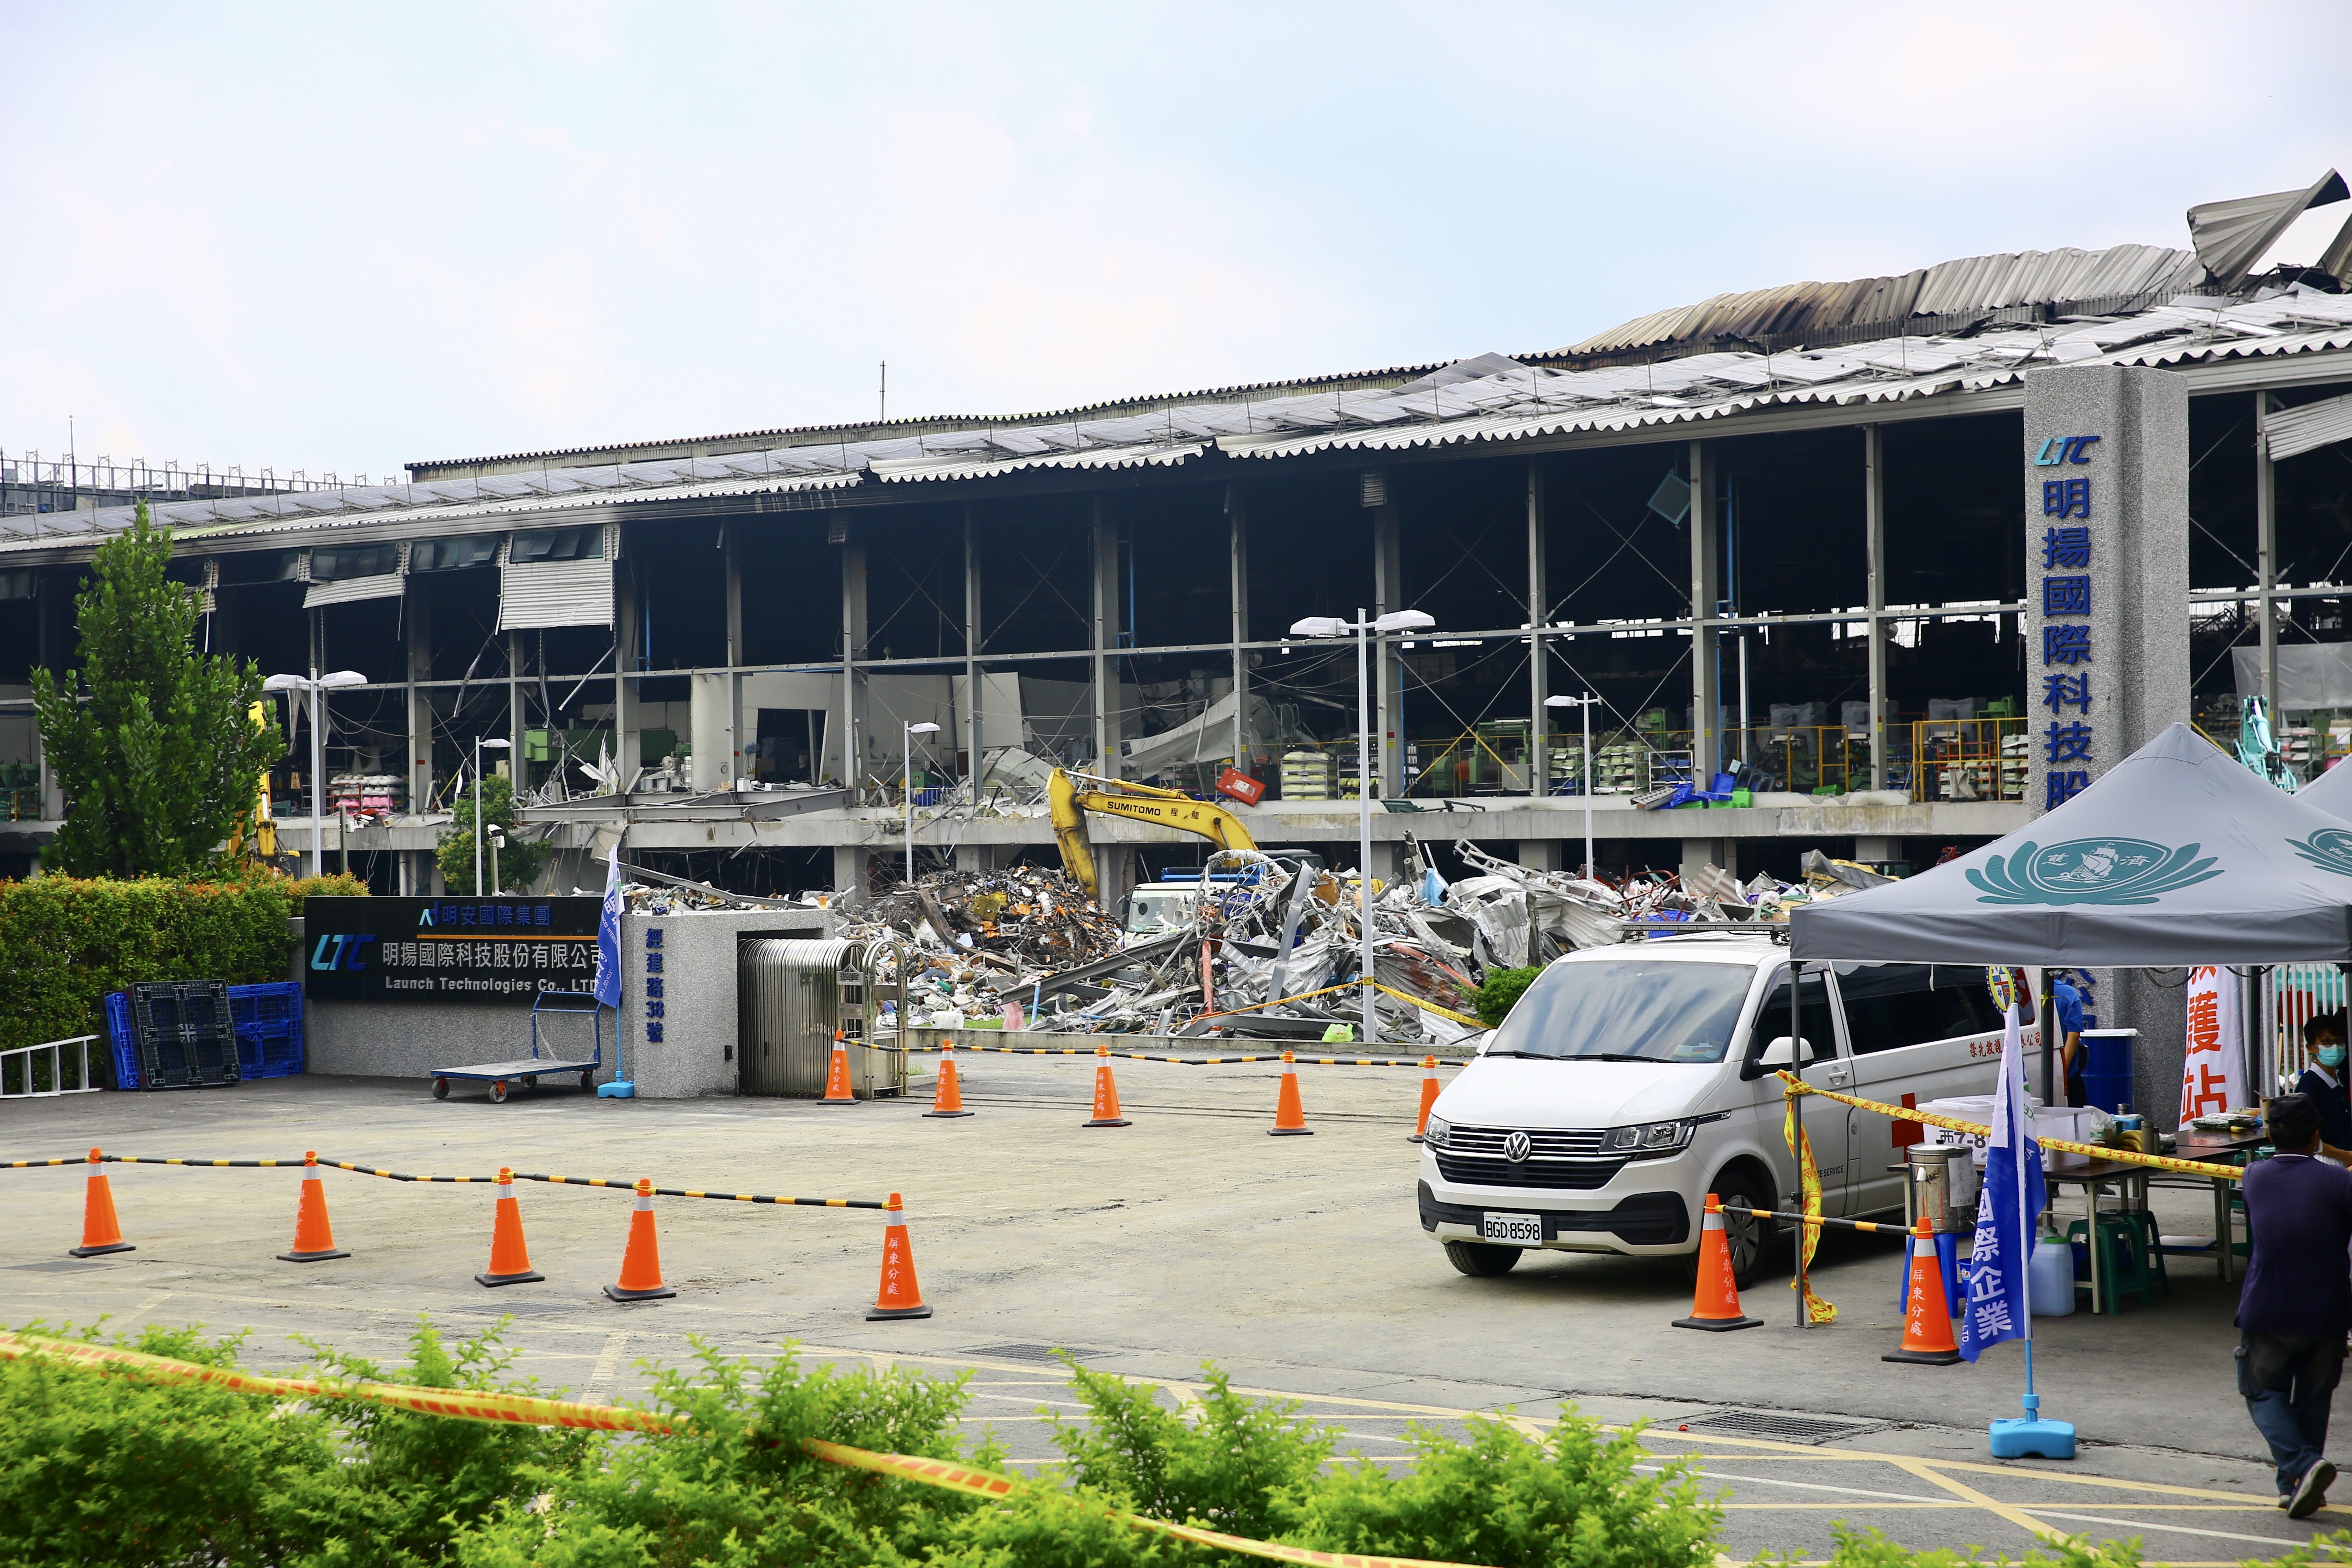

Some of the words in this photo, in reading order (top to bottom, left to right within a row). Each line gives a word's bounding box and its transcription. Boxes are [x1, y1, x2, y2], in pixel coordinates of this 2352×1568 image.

[2034, 435, 2100, 466] LTC
[1107, 802, 1161, 816] SUMITOMO
[443, 905, 550, 926] 明安國際集團
[311, 934, 377, 971] LTC
[385, 976, 434, 989] Launch
[439, 977, 532, 994] Technologies
[646, 928, 664, 1043] 經建路38號
[832, 1057, 842, 1092] 屏東分處
[937, 1067, 947, 1104] 屏東分處
[1096, 1073, 1106, 1110] 屏東分處
[1824, 1165, 1844, 1178] SERVICE
[888, 1237, 900, 1295] 屏東分處
[1719, 1243, 1736, 1305] 屏東分處
[1909, 1269, 1925, 1336] 屏東分處
